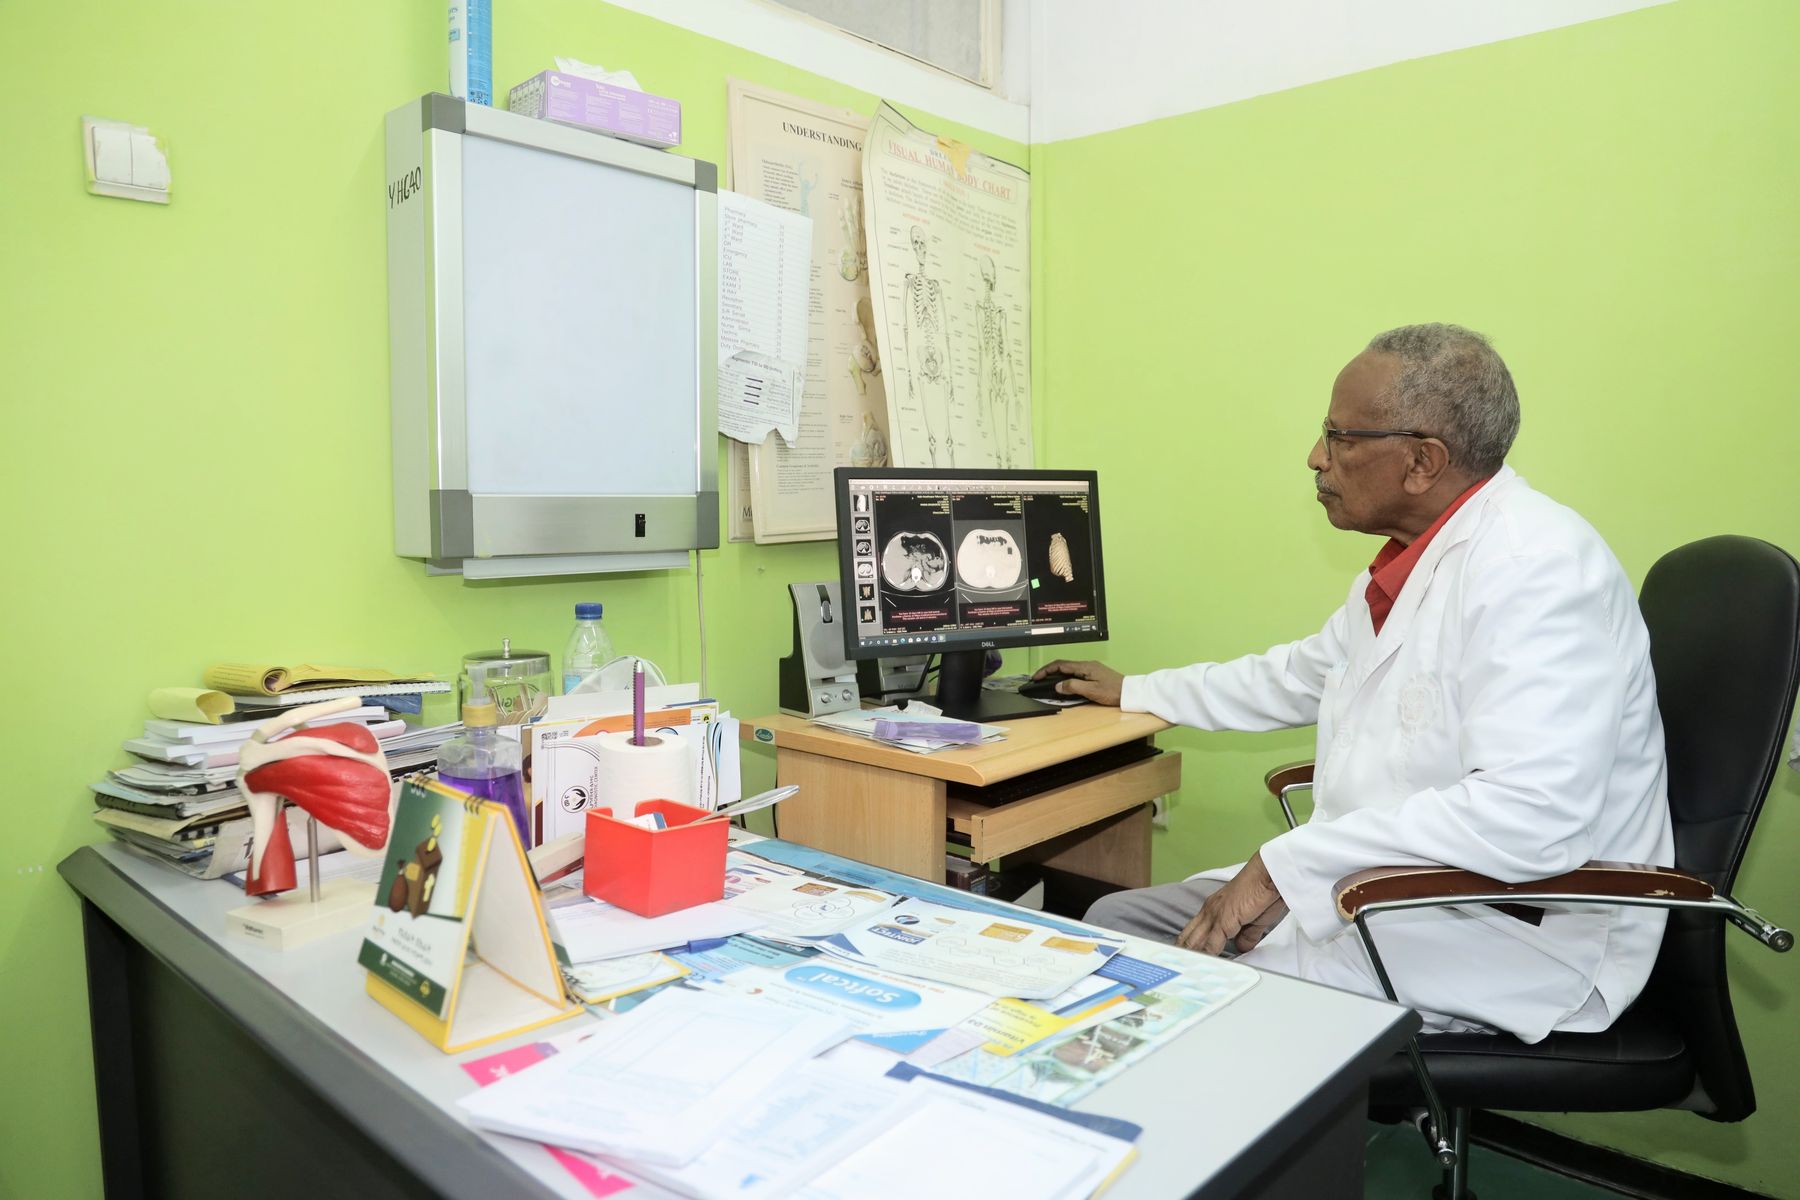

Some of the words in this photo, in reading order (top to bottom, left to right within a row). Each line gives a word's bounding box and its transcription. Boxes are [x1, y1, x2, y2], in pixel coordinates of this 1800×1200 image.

[782, 121, 862, 151] UNDERSTANDING
[888, 140, 918, 161] VISUAL
[982, 180, 1011, 200] CHART
[809, 972, 900, 1003] Softcal
[983, 1024, 1025, 1044] Vitamin
